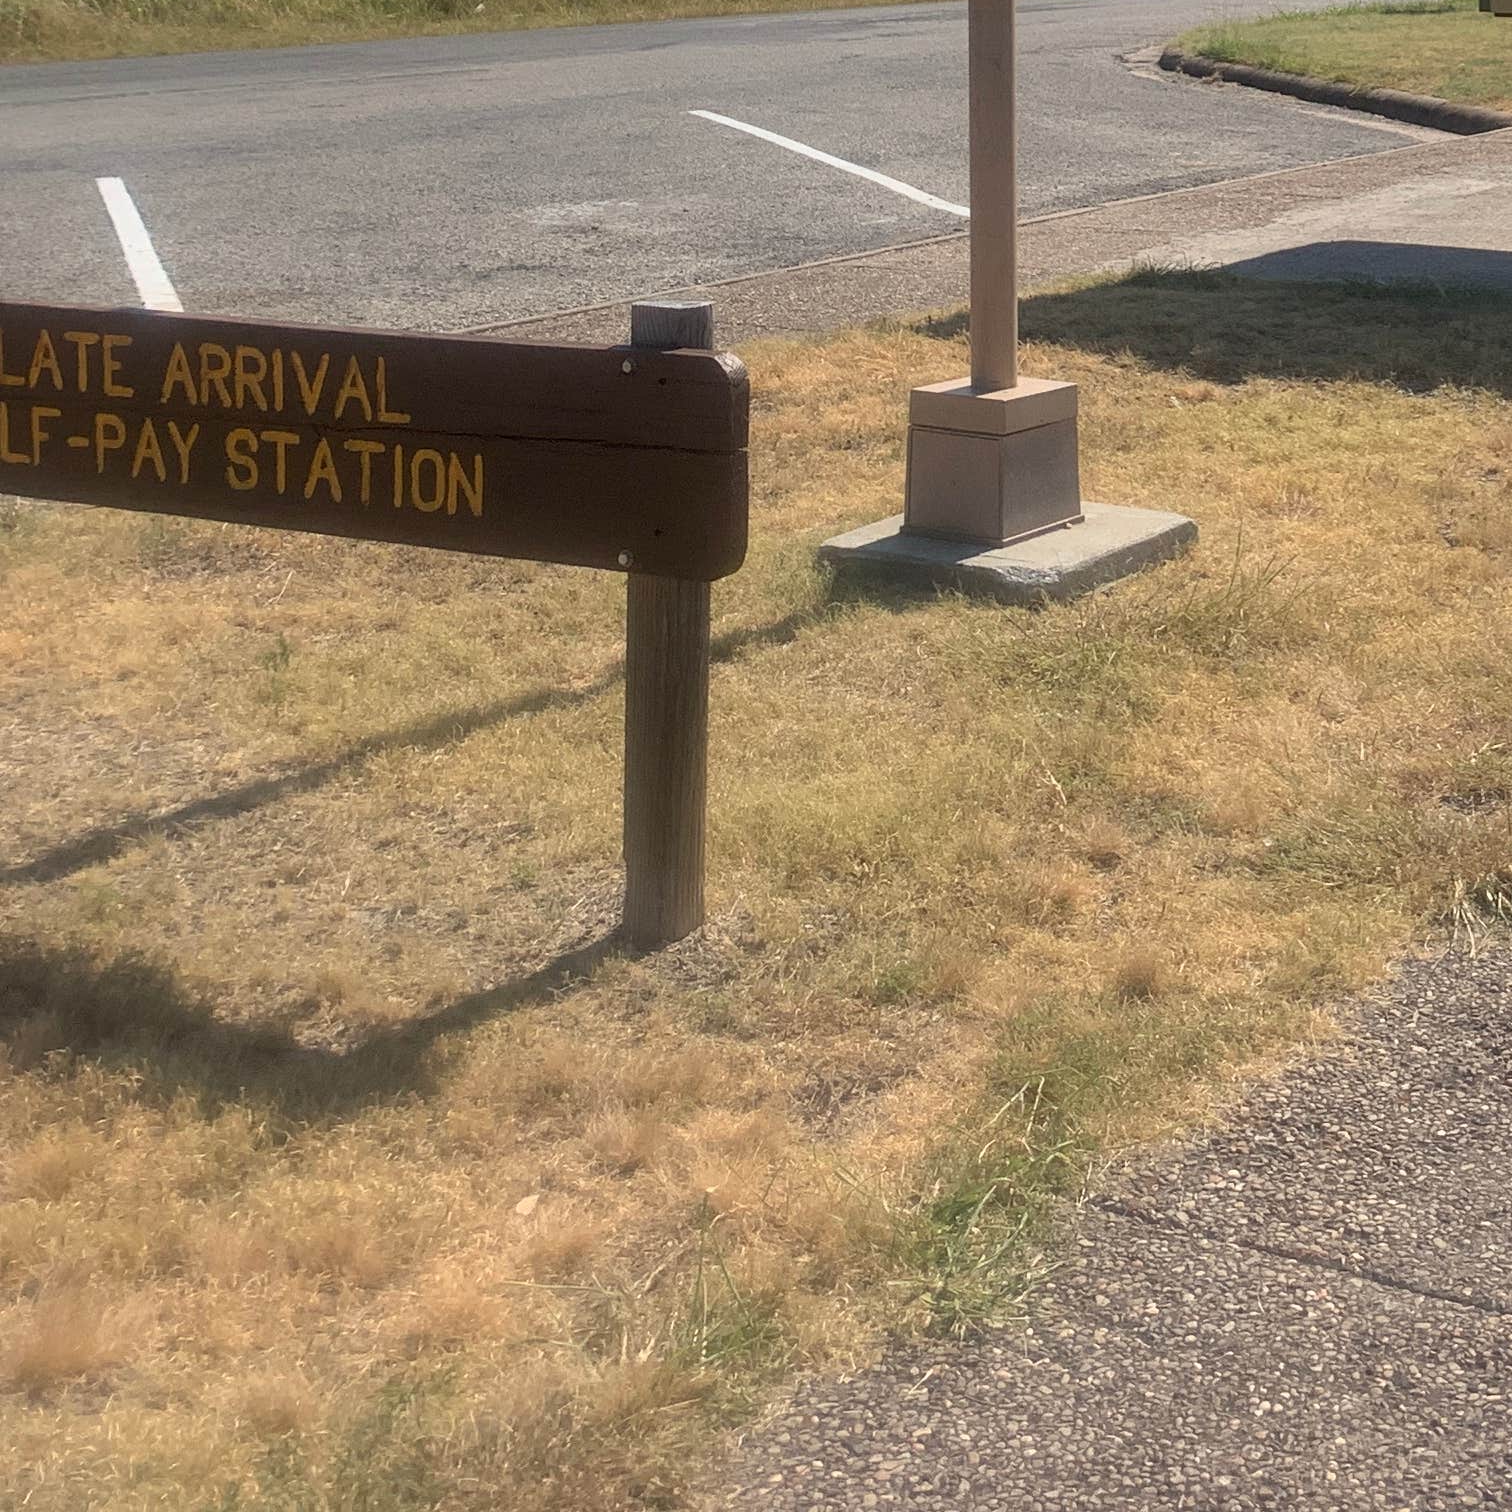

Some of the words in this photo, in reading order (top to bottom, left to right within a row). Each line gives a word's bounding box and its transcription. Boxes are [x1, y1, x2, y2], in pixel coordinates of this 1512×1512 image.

[0, 327, 134, 398] LATE
[160, 342, 411, 425] ARRIVAL
[225, 428, 484, 517] STATION
